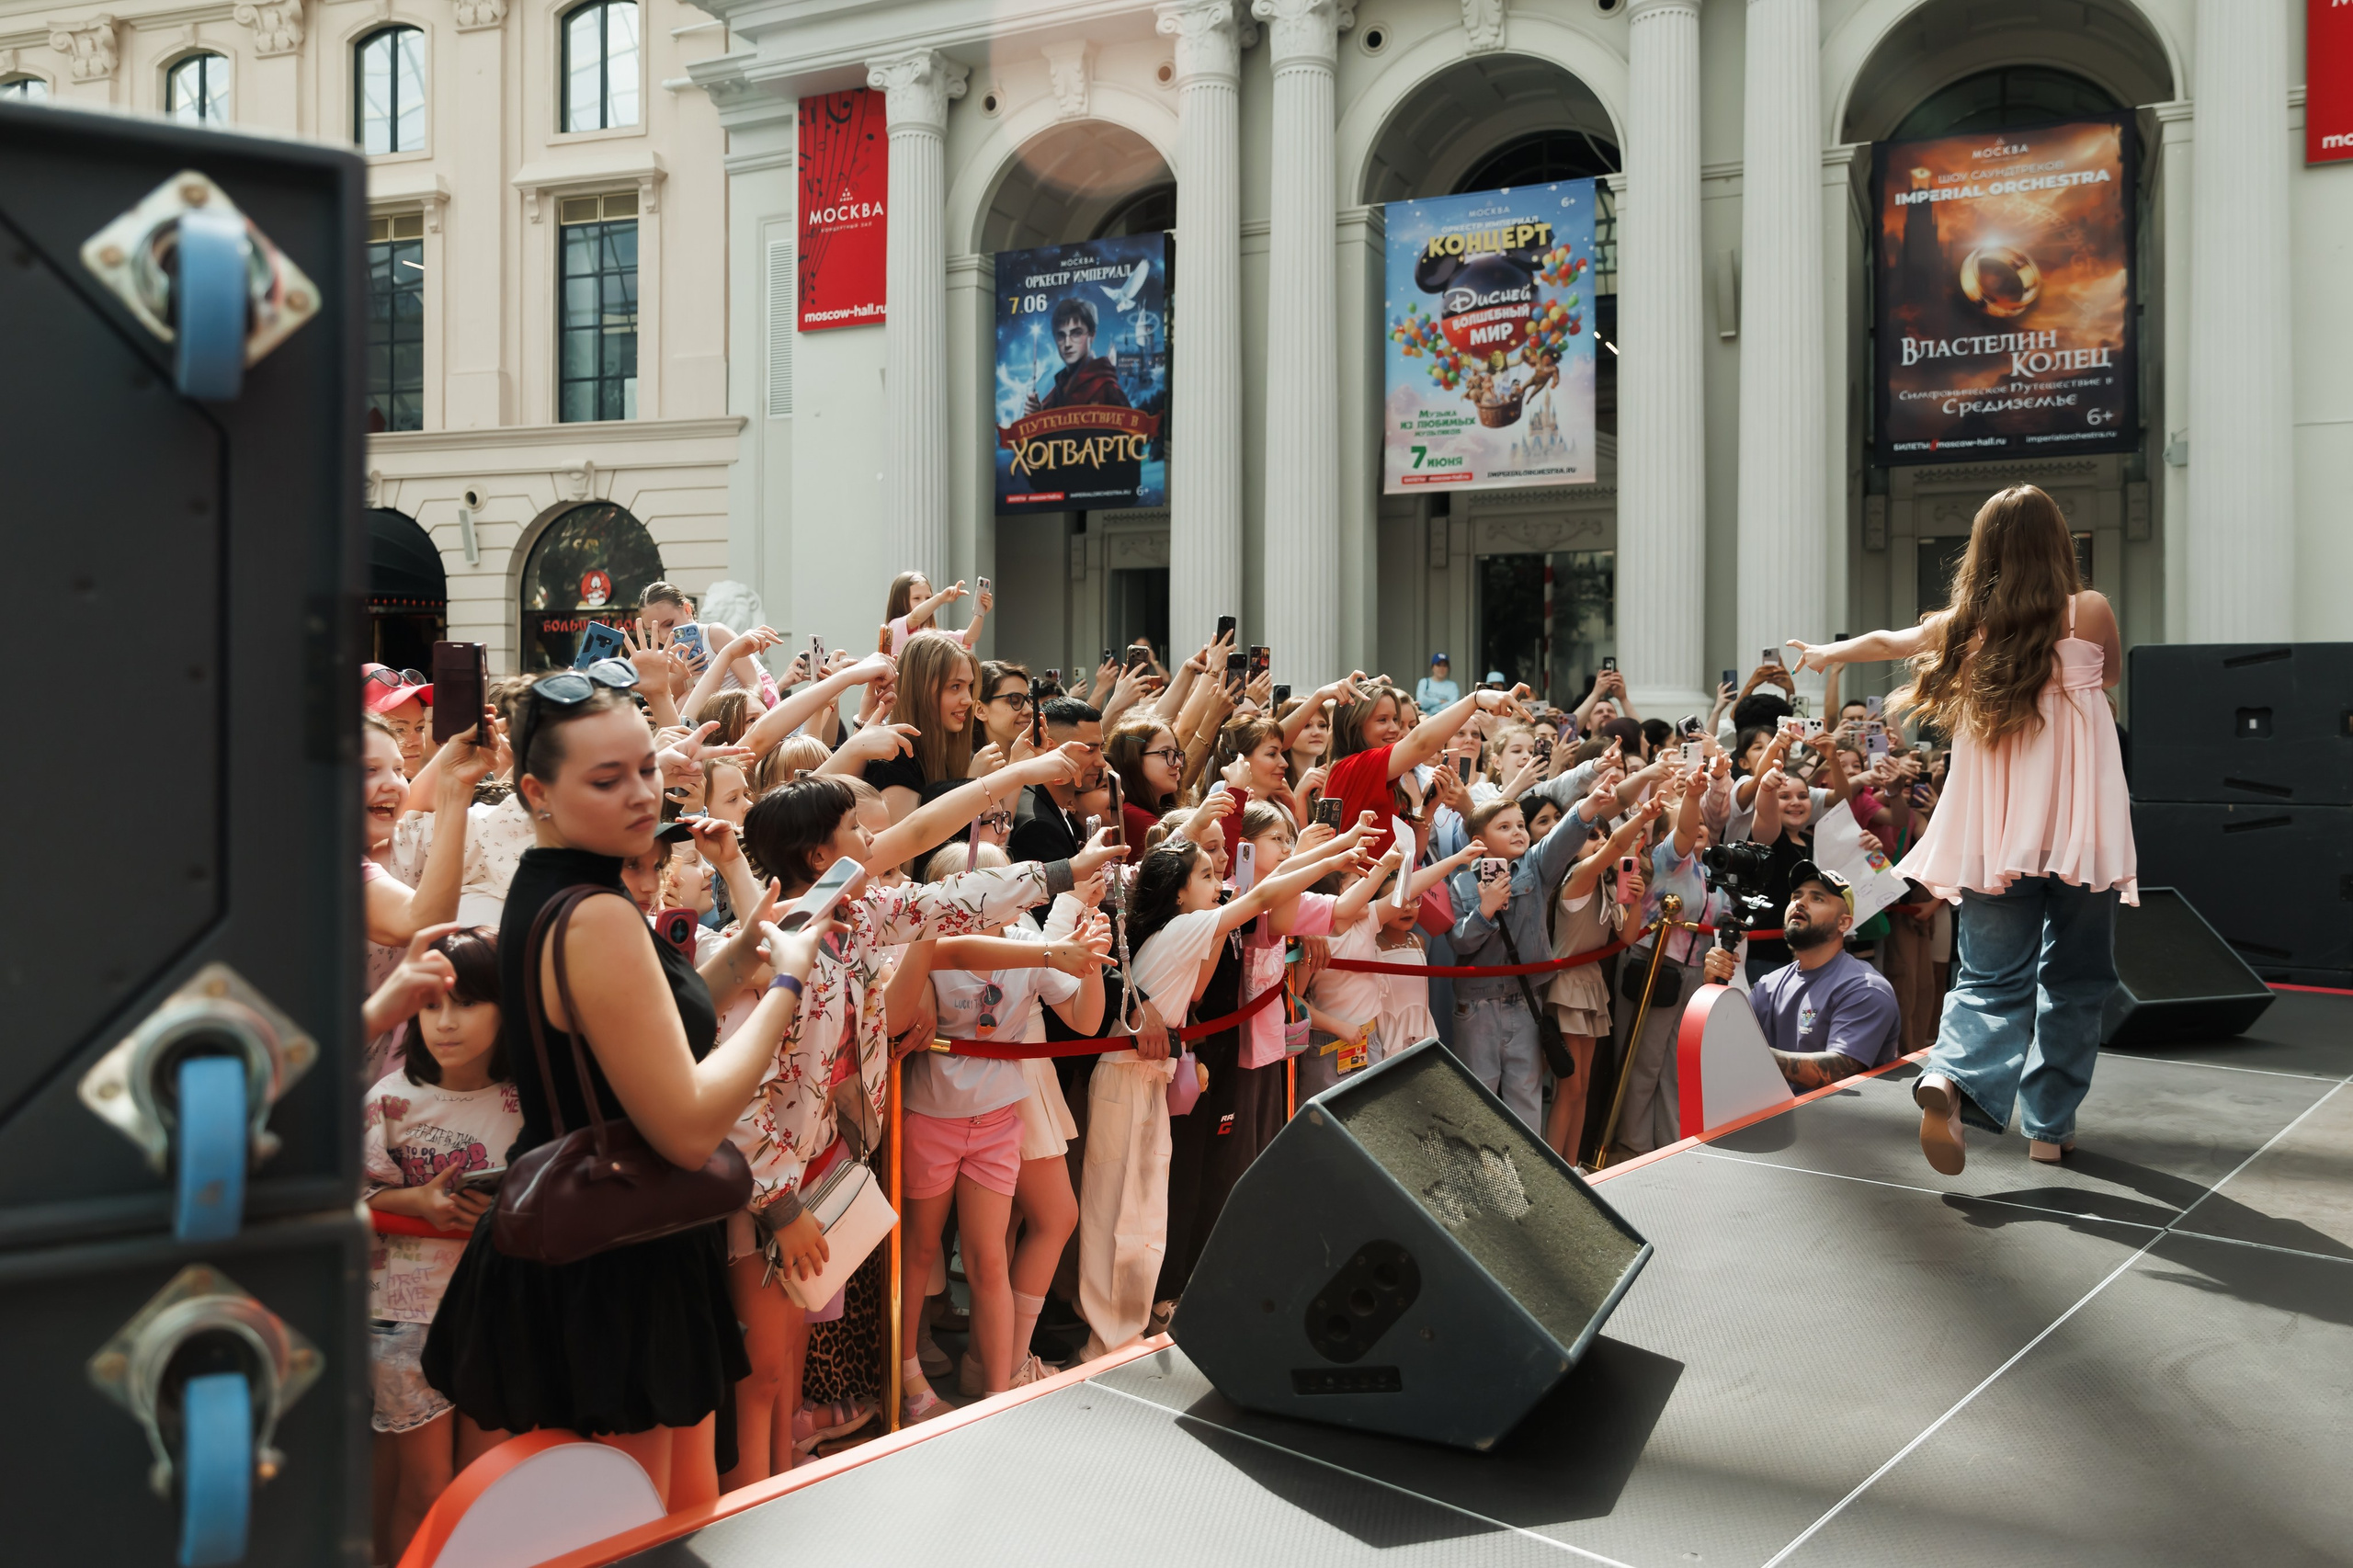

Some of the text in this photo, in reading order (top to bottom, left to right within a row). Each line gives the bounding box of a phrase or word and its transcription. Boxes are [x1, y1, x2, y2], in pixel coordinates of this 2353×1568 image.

[1972, 143, 2029, 159] МОСКВА
[1938, 172, 1968, 184] ШОУ
[1971, 160, 2065, 181] САУНДТРЕКОВ
[1895, 168, 2111, 206] IMPERIAL ORCHESTRA
[809, 200, 884, 225] МОСКВА
[1469, 206, 1510, 218] МОСКВА
[1561, 197, 1576, 208] 6+
[1441, 215, 1539, 234] ОРКЕСТР ИМПЕРИАЛ
[1428, 223, 1552, 257] КОНЦЕРТ
[1061, 256, 1094, 267] МОСКВА
[1026, 264, 1132, 289] ОРКЕСТР ИМПЕРИАЛ
[1008, 293, 1048, 314] 7.06
[1452, 304, 1529, 331] ВОЛШЕБНЫЙ
[1470, 322, 1514, 346] МИР
[1018, 411, 1140, 437] ПУТЕШЕСТВИЕ В
[2086, 407, 2114, 426] 6+
[1936, 437, 2006, 449] moscow-hall.ru
[1007, 433, 1149, 476] ХОГВАРТС
[1411, 446, 1462, 469] 7 ИЮНЯ
[1136, 485, 1149, 496] 6+
[543, 616, 610, 632] БОЛЬШЙ
